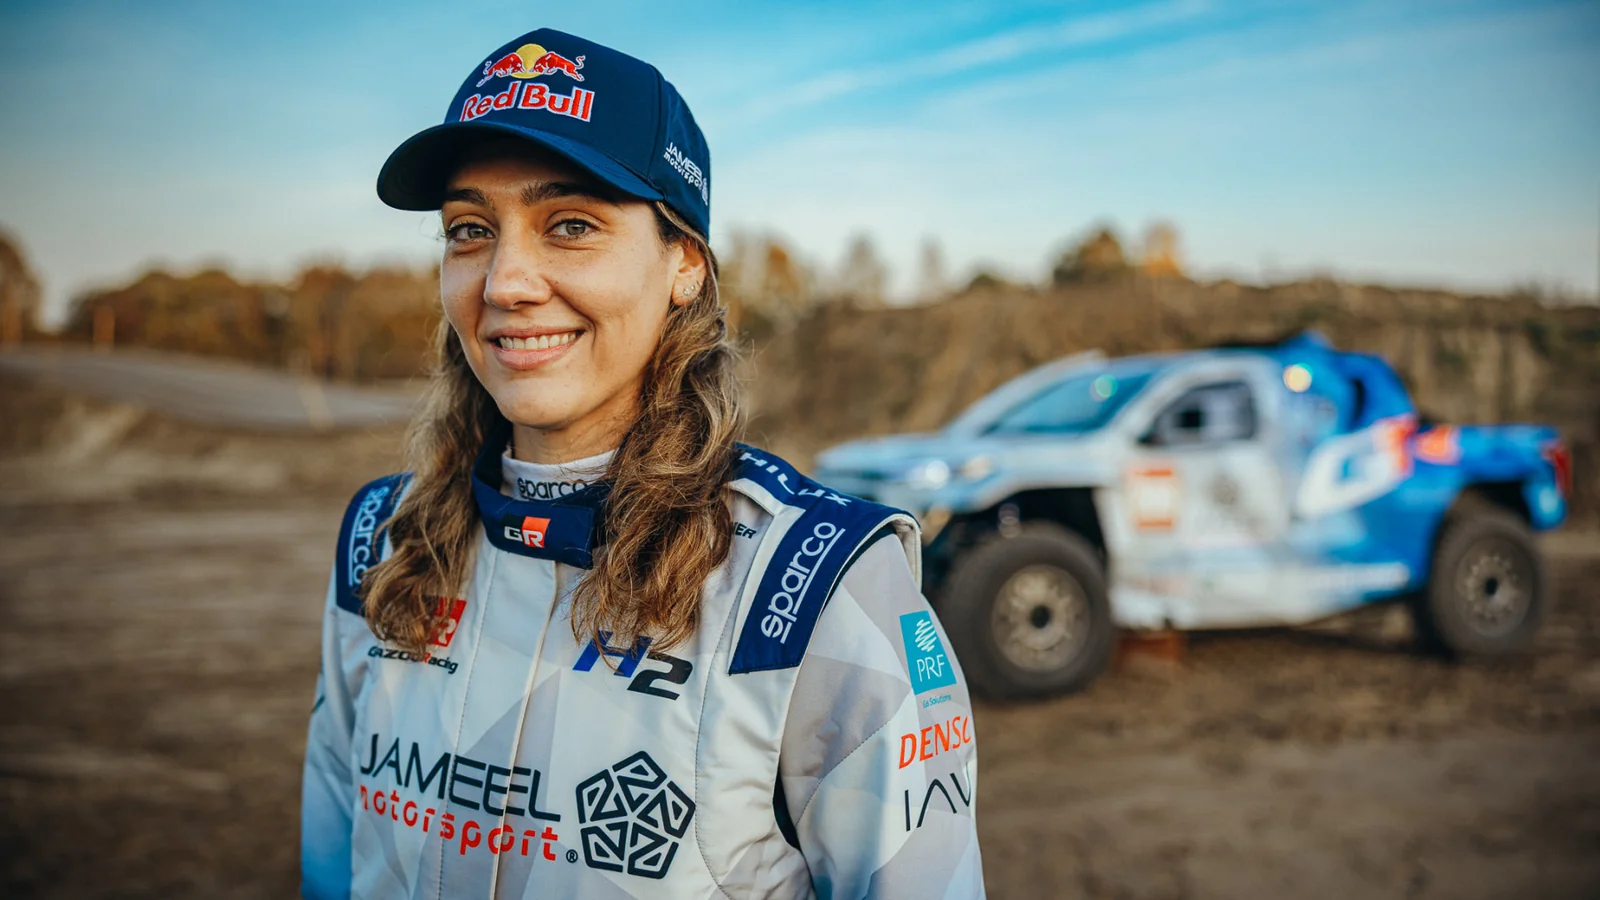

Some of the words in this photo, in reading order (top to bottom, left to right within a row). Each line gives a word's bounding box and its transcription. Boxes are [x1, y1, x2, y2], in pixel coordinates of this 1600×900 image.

[460, 81, 521, 122] Red
[518, 83, 595, 122] Bull
[517, 477, 588, 500] sparco
[504, 526, 545, 549] GR
[761, 522, 837, 638] sparco
[572, 630, 693, 701] H2
[916, 654, 945, 682] PRF
[360, 734, 561, 822] JAMEEL
